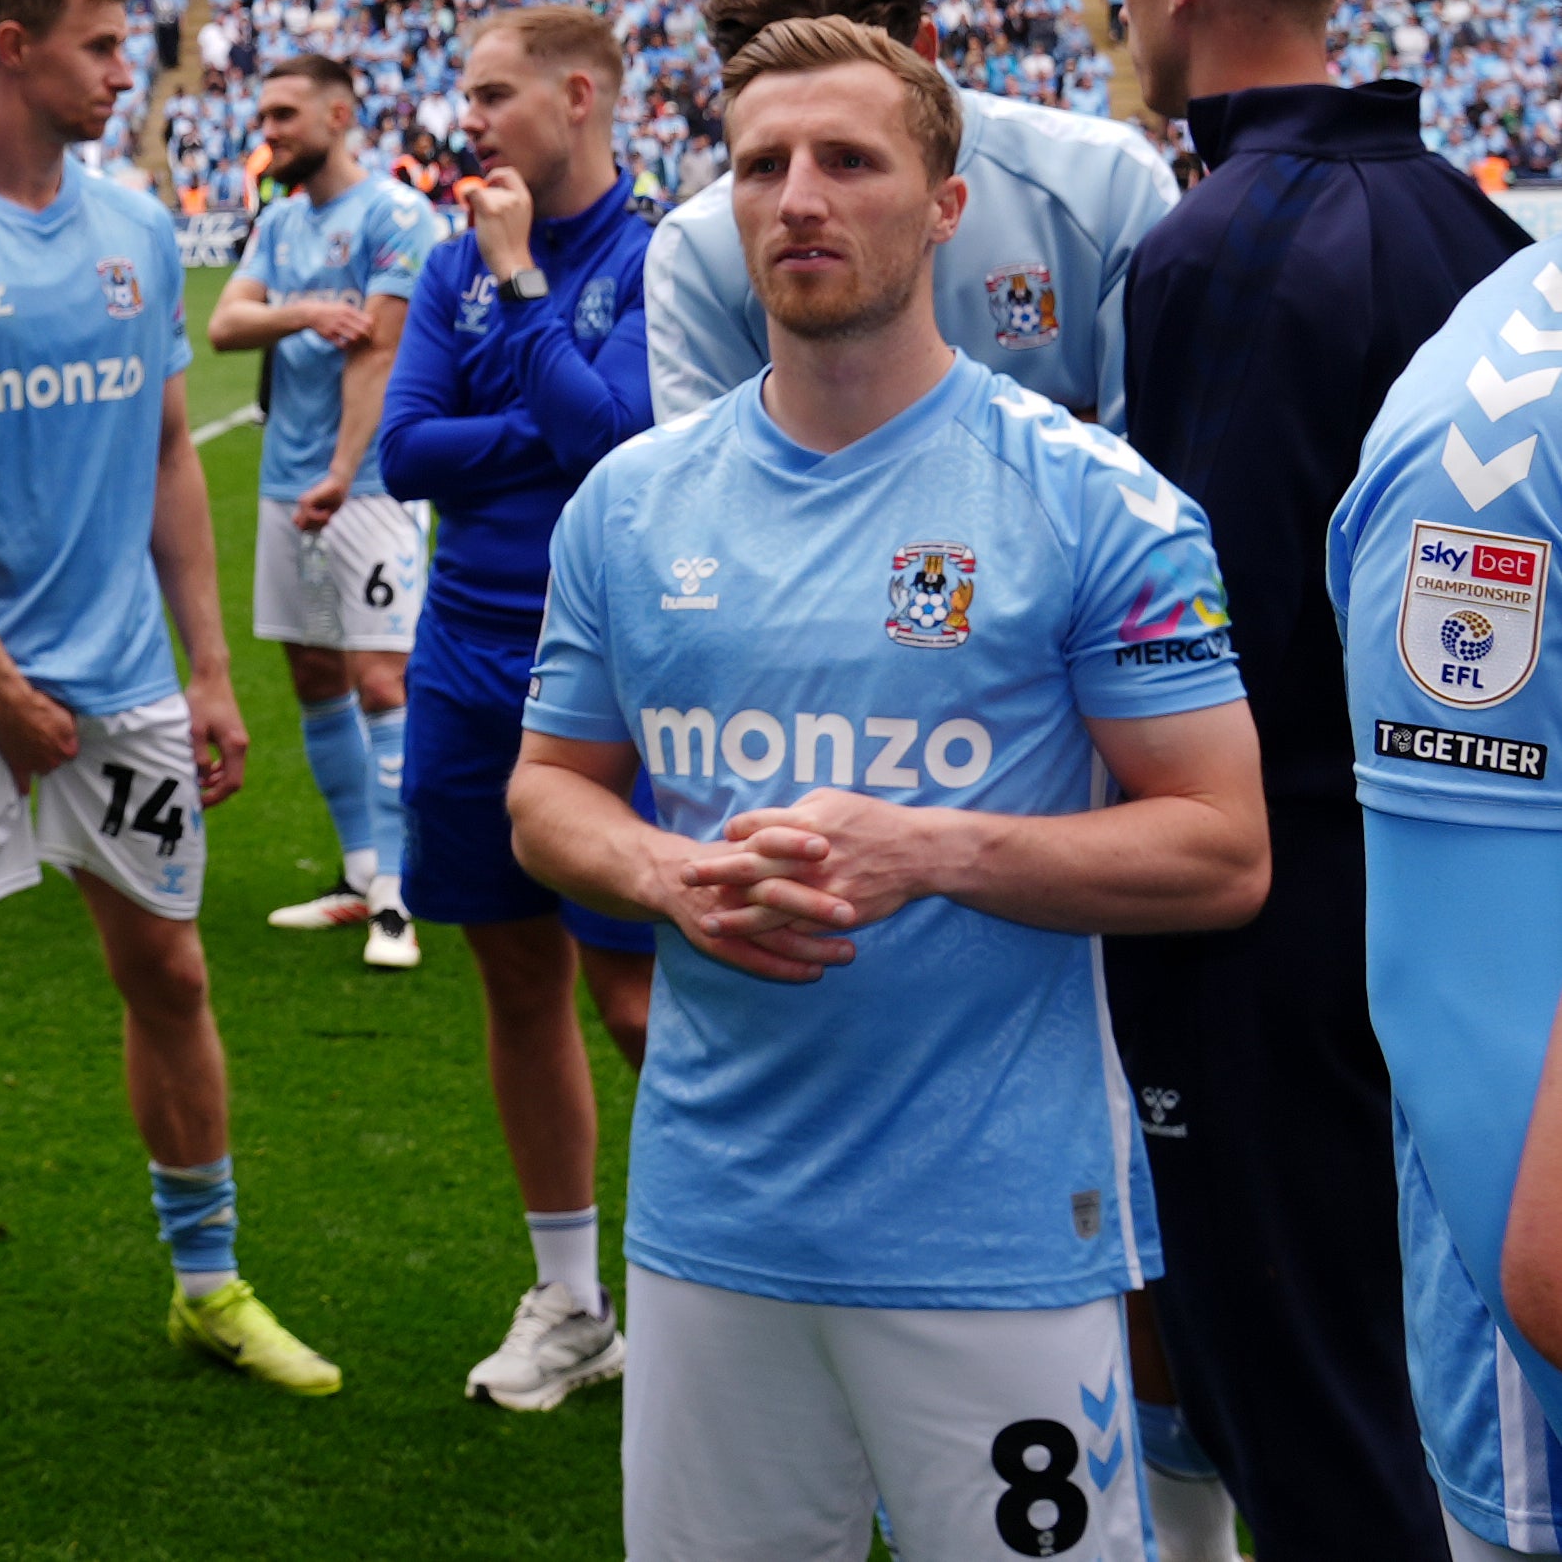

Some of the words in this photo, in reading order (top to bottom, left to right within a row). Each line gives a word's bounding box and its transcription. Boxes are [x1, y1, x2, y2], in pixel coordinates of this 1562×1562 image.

[1420, 540, 1469, 572] sky
[1478, 548, 1529, 578] bet
[364, 561, 394, 609] 6
[1415, 574, 1532, 605] CHAMPIONSHIP
[1441, 663, 1485, 690] EFL
[640, 706, 993, 789] monzo
[100, 762, 184, 857] 14
[991, 1417, 1089, 1558] 8
